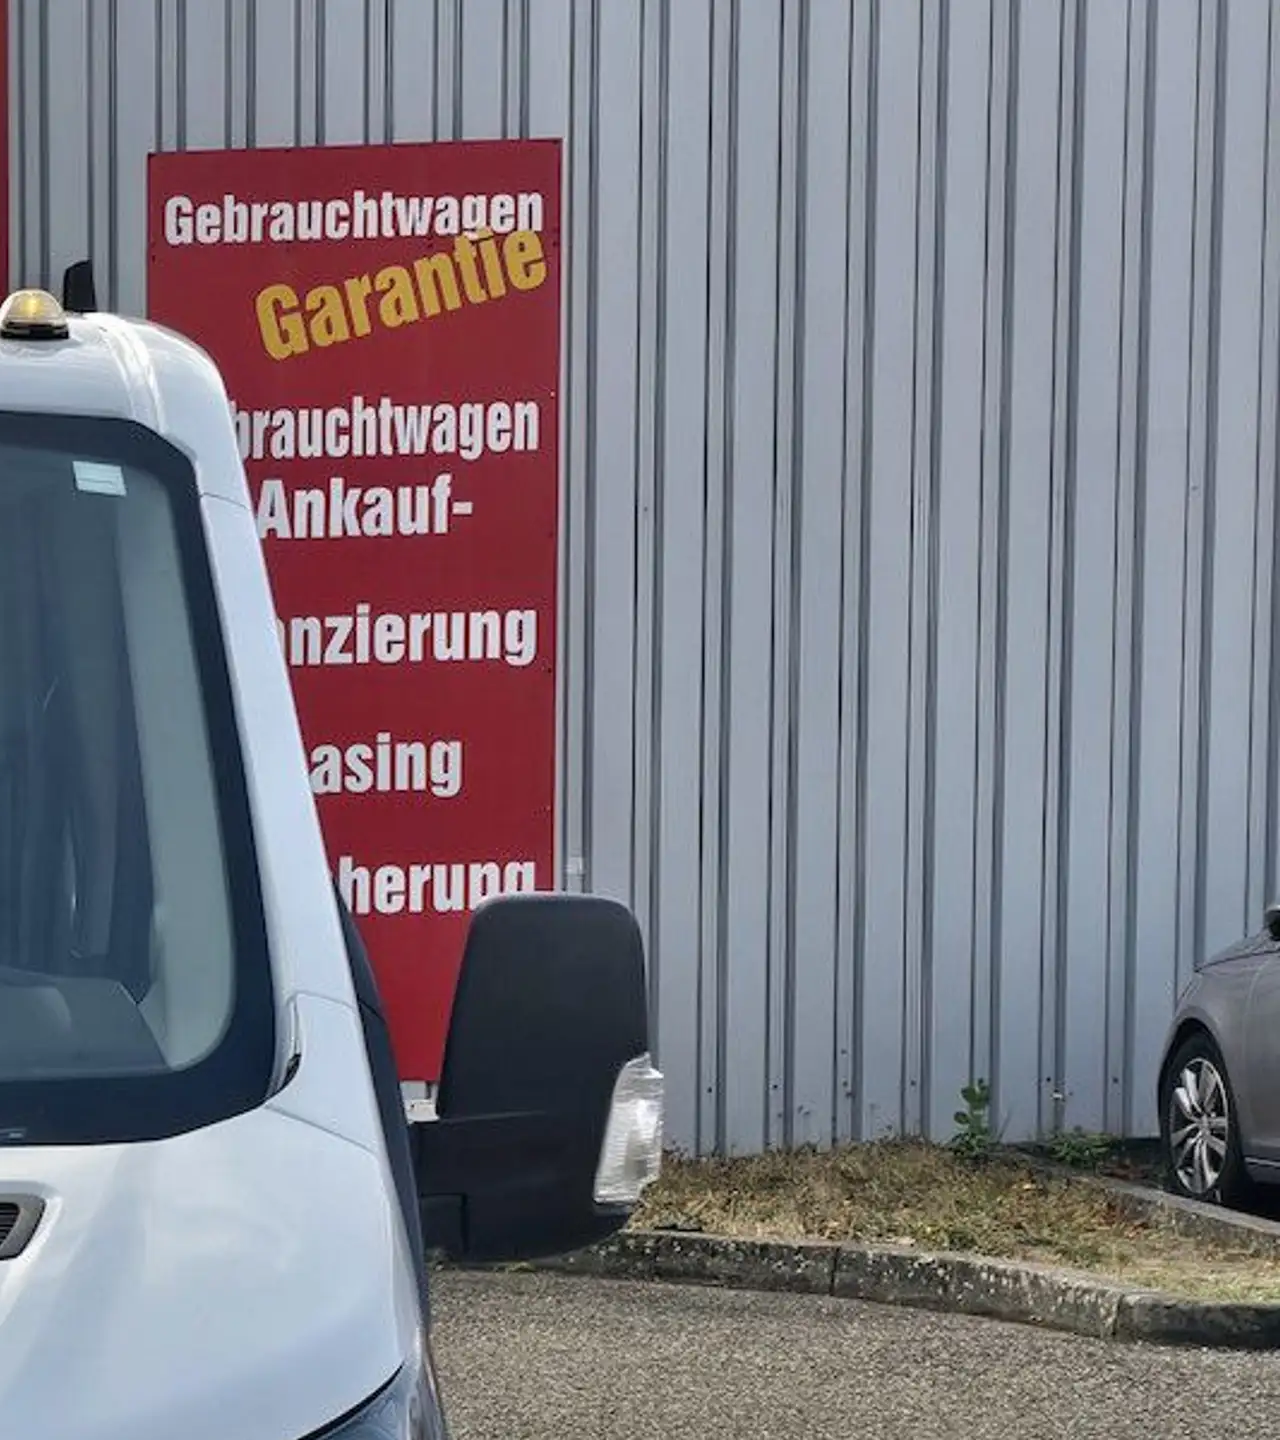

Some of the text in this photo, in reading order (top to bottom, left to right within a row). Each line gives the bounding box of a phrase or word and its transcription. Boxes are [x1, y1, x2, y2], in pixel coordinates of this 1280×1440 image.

[165, 190, 543, 245] Gebrauchtwagen
[256, 228, 547, 360] Garantie
[257, 473, 473, 539] Ankauf-
